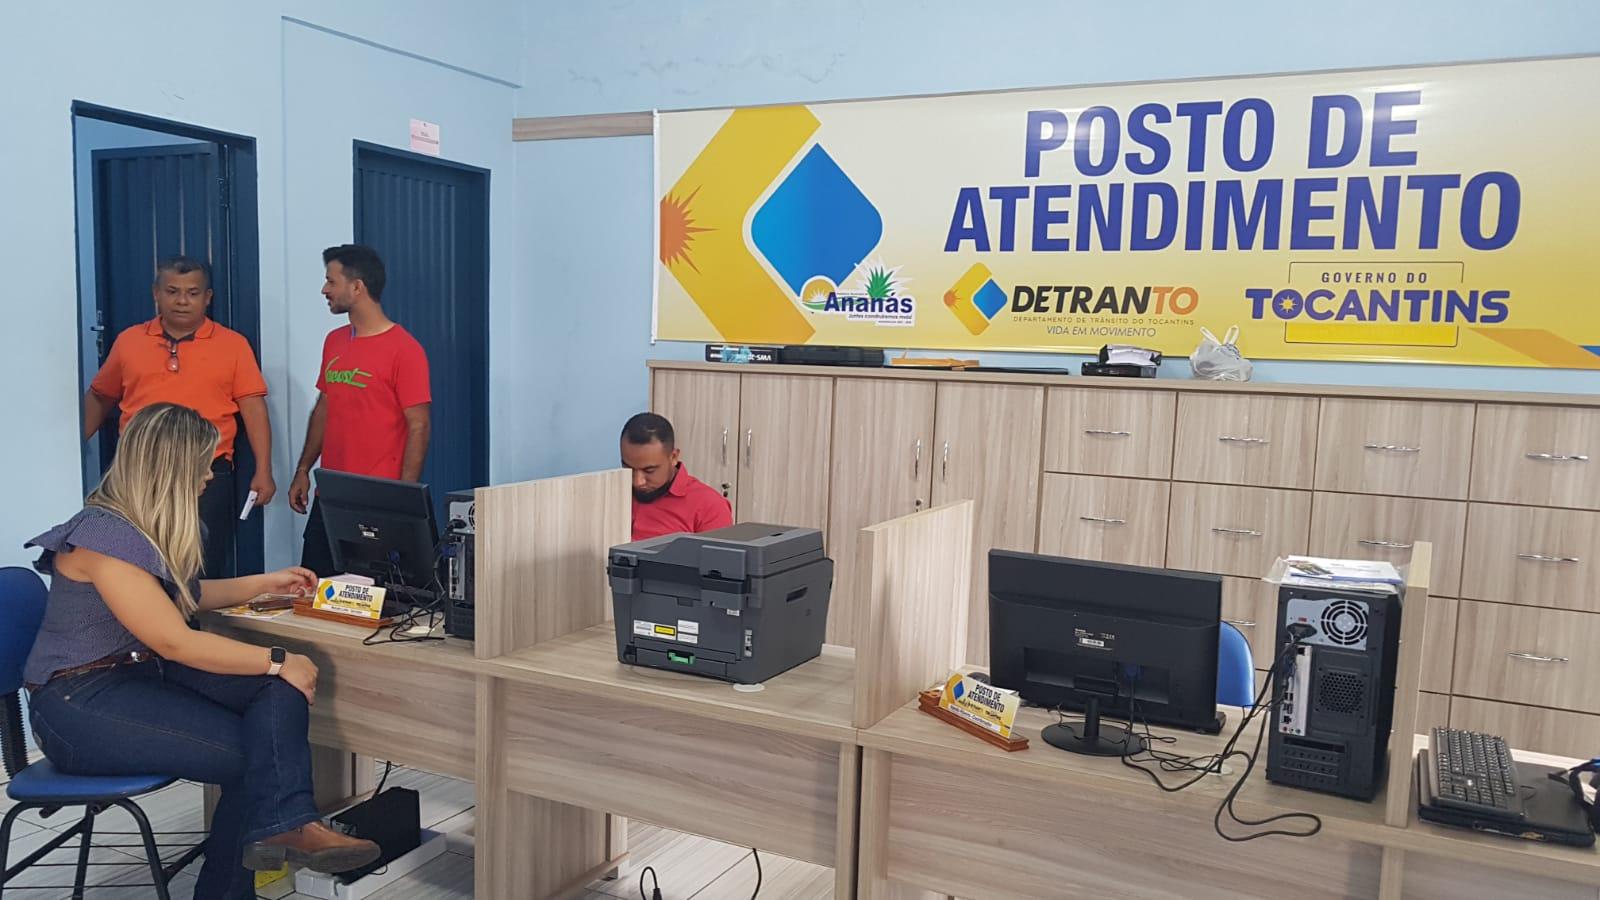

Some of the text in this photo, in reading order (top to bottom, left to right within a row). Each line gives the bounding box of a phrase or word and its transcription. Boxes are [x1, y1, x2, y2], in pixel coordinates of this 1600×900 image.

[1024, 90, 1421, 178] POSTO DE
[944, 171, 1521, 252] ATENDIMENTO
[1321, 271, 1428, 284] GOVERNO DO
[823, 291, 913, 313] Ananás
[1245, 288, 1511, 323] TOCANTINS
[1013, 316, 1073, 324] DEPARTAMENTO
[1090, 316, 1129, 325] TRÂNSITO
[1148, 318, 1195, 326] TOCANTINS
[1047, 326, 1157, 338] VIDA EM MOVIMENTO
[339, 591, 373, 602] ATENDIMENTO
[345, 585, 361, 593] POSTO
[975, 685, 1002, 701] POSTO DE
[968, 691, 1005, 713] ATENDIMENTO
